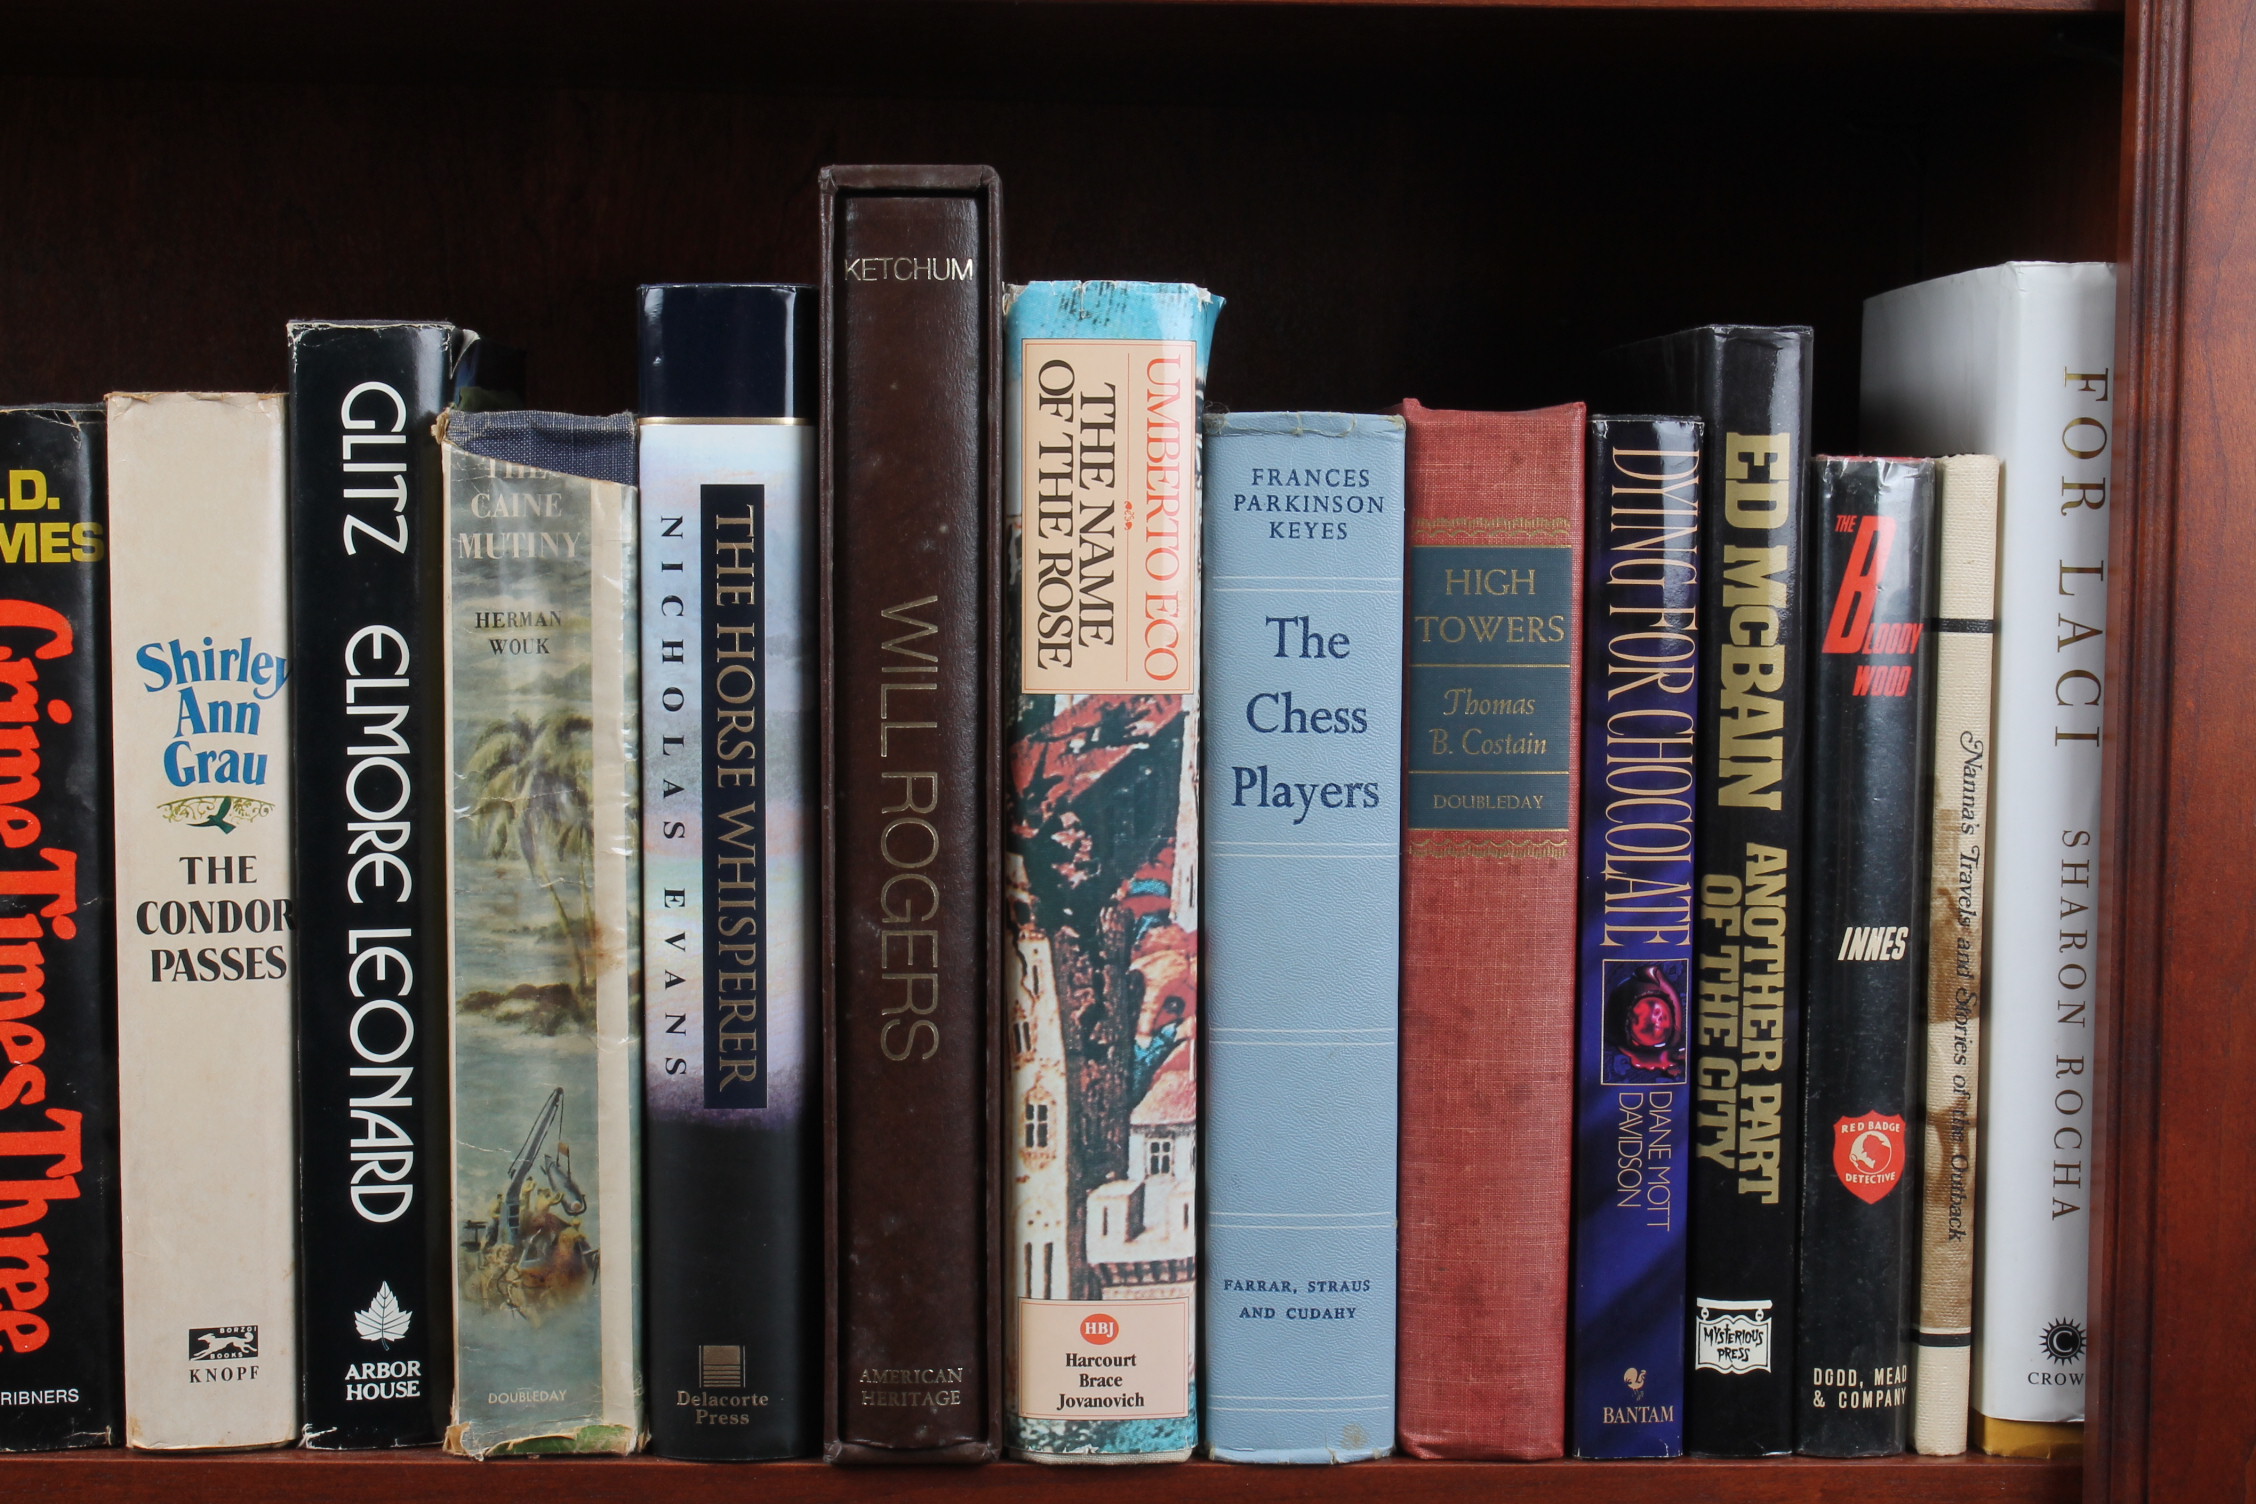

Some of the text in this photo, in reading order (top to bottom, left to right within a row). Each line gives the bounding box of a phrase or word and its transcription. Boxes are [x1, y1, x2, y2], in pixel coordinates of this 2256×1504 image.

[844, 257, 974, 281] KETCHUM
[1251, 468, 1370, 487] FRANCES
[1725, 432, 1791, 529] ED
[471, 493, 563, 519] CAINE
[1036, 359, 1075, 671] OF THE ROSE
[1078, 382, 1116, 648] THE NAME
[1143, 354, 1182, 681] UMBERTO ECO
[1233, 494, 1384, 515] PARKINSON
[1268, 520, 1348, 540] KEYES
[1835, 515, 1857, 532] THE
[458, 532, 581, 560] MUTINY
[2054, 366, 2109, 748] FOR LACI
[1445, 568, 1536, 597] HIGH
[1822, 515, 1924, 655] BLOODY
[475, 611, 562, 629] HERMAN
[1414, 615, 1566, 644] TOWERS
[489, 638, 550, 656] WOUK
[1265, 615, 1350, 660] The
[136, 636, 294, 700] Shirley
[1852, 665, 1912, 697] WOOD
[1443, 687, 1536, 716] Thomas
[1600, 446, 1700, 948] DYING FOR CHOCOLATE
[173, 685, 261, 739] Ann
[1246, 692, 1368, 734] Chess
[1430, 728, 1548, 756] B. Costain
[164, 741, 268, 787] Grau
[660, 514, 688, 1077] NICHOLAS EVANS
[1231, 764, 1380, 825] Players
[1959, 730, 1984, 836] Nanna's
[341, 381, 414, 1223] GLITZ ELMORE LEONARD
[716, 504, 758, 1093] THE HORSE WHISPERER
[1432, 793, 1544, 810] DOUBLEDAY
[880, 594, 940, 1063] WILL ROGERS
[180, 855, 258, 885] THE
[1956, 845, 1980, 928] Travels
[136, 898, 297, 936] CONDOR
[1838, 926, 1909, 961] INNES
[150, 945, 287, 983] PASSES
[1955, 937, 1975, 979] and
[1696, 874, 1743, 1169] OF THE CITY
[1738, 842, 1788, 1204] ANOTHER PART
[1953, 987, 1977, 1066] Stories
[2052, 830, 2091, 1222] SHARON ROCHA
[1953, 1074, 1971, 1101] of
[1841, 1120, 1901, 1134] RED BADGE
[1616, 1092, 1644, 1207] DAVIDSON
[1646, 1091, 1673, 1232] DIANE MOTT
[1845, 1171, 1896, 1184] DETECTIVE
[1948, 1153, 1969, 1243] Outback
[1223, 1279, 1372, 1295] FARRAR, STRAUS
[1239, 1305, 1357, 1320] AND CUDAHY
[1084, 1321, 1115, 1338] HBJ
[1704, 1323, 1764, 1347] MYSTERIOUS
[1064, 1351, 1138, 1369] Harcourt
[1717, 1347, 1751, 1362] PRESS
[189, 1365, 259, 1383] KNOPF
[344, 1361, 421, 1382] ARBOR
[859, 1367, 964, 1385] AMERICAN
[1078, 1372, 1124, 1389] Brace
[1813, 1364, 1907, 1389] DODD, MEAD
[2027, 1372, 2085, 1386] CROW
[0, 1388, 80, 1406] RIBNERS
[345, 1380, 420, 1401] HOUSE
[487, 1389, 568, 1405] DOUBLEDAY
[676, 1390, 769, 1407] Delacorte
[861, 1388, 962, 1407] HERITAGE
[1056, 1392, 1145, 1411] Jovanovich
[1813, 1387, 1907, 1409] & COMPANY
[695, 1408, 750, 1426] Press
[1602, 1404, 1675, 1424] BANTAM
